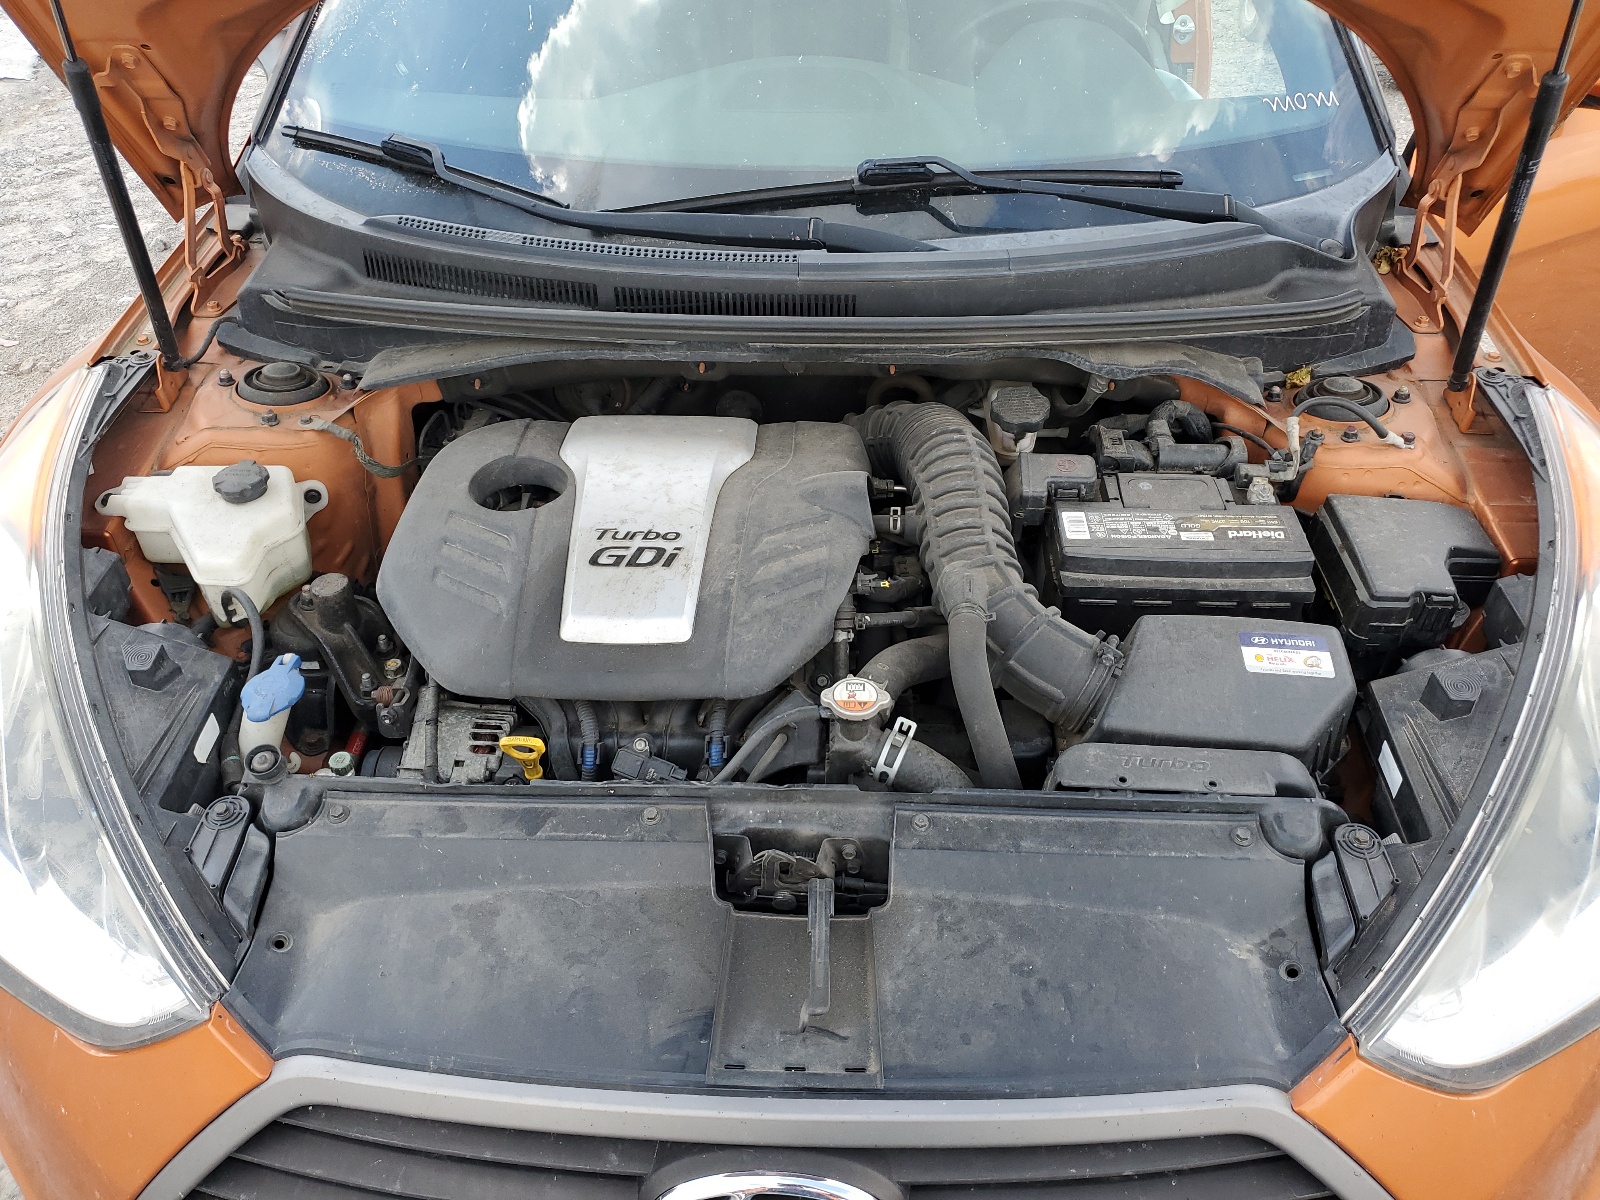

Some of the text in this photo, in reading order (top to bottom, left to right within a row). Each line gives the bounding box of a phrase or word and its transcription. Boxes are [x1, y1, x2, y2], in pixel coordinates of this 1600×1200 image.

[595, 528, 682, 541] Turbo
[1227, 530, 1286, 539] DieHard
[588, 546, 684, 568] GDi
[1270, 637, 1316, 647] HYUNDAI
[1120, 754, 1211, 772] Turbo
